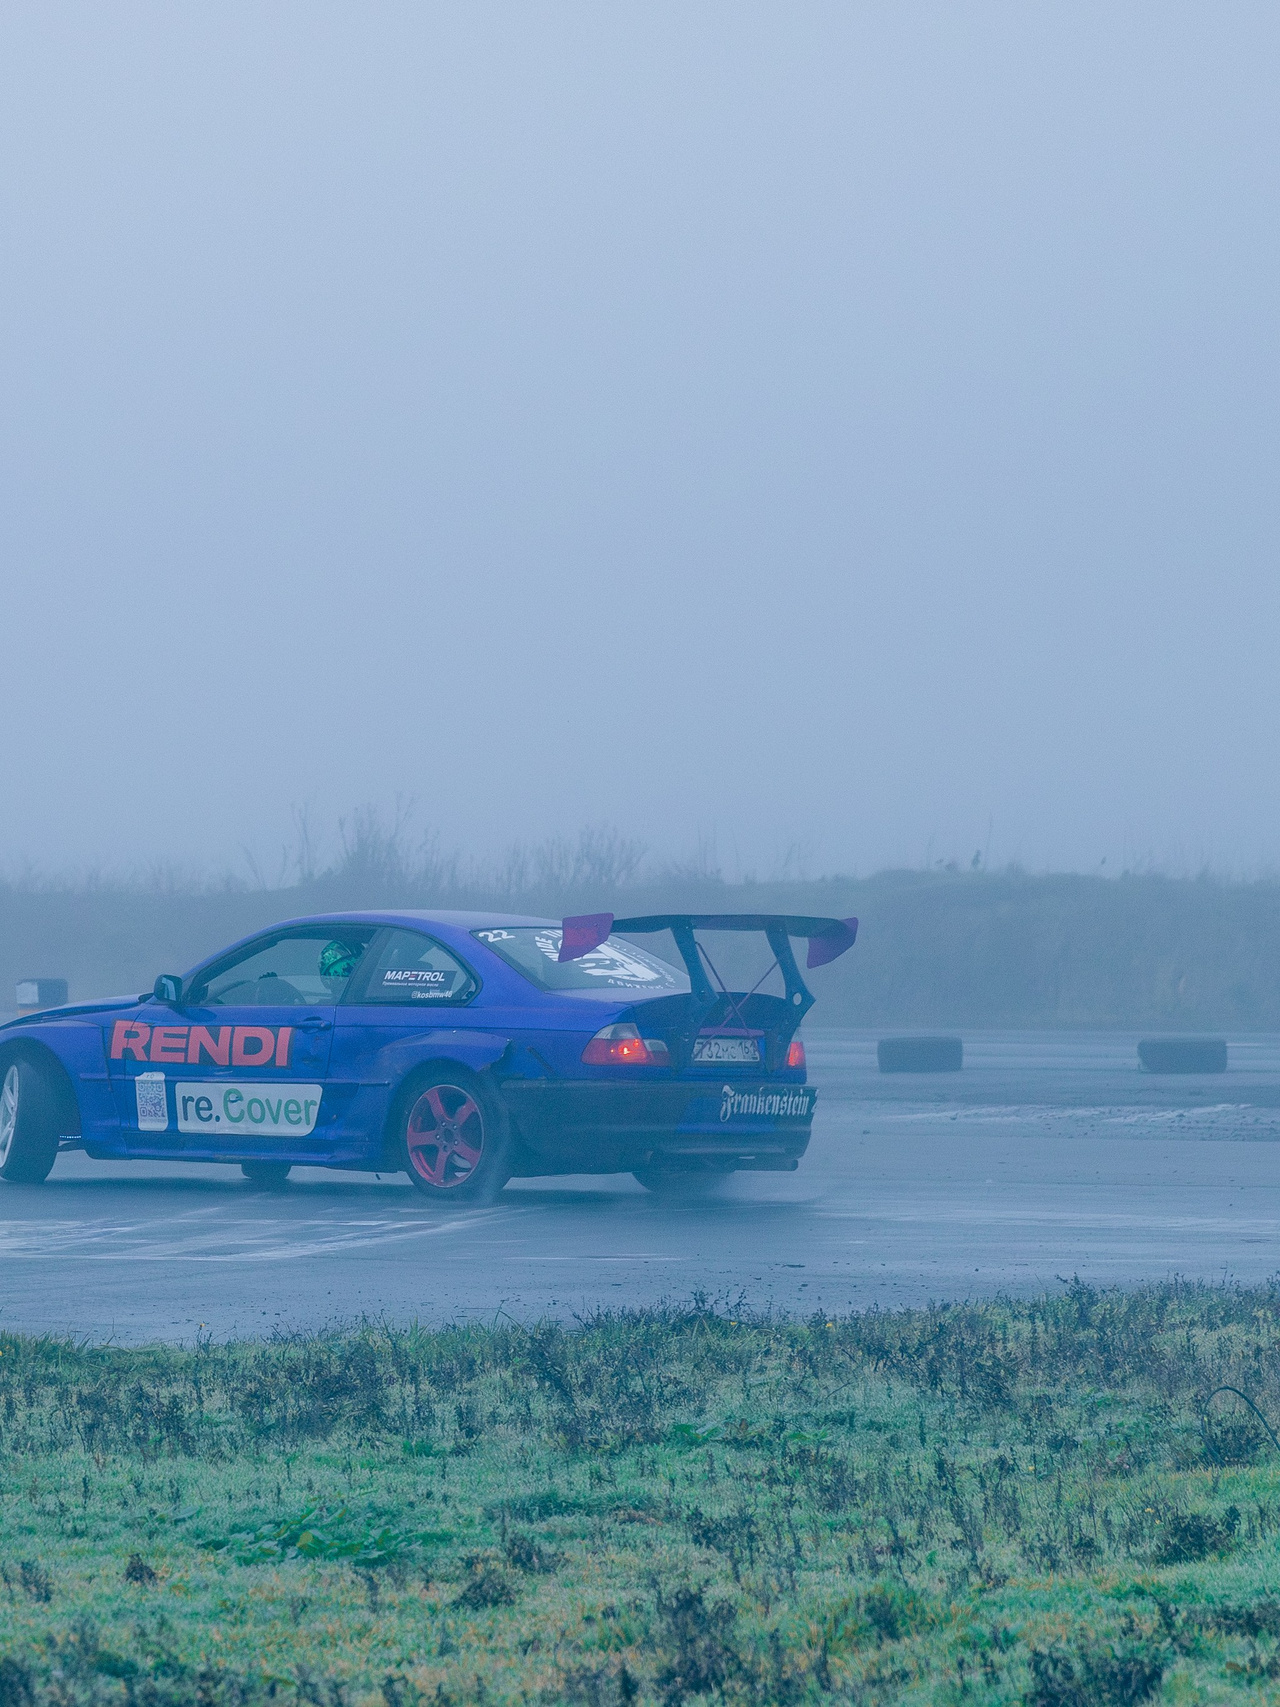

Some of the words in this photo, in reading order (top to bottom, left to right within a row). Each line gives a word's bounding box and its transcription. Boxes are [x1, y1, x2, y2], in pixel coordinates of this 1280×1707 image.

[478, 929, 516, 943] 22
[384, 970, 445, 981] MAPETROL
[110, 1020, 292, 1066] RENDI
[181, 1088, 318, 1126] re.Cover
[720, 1084, 809, 1123] Frankenstein
